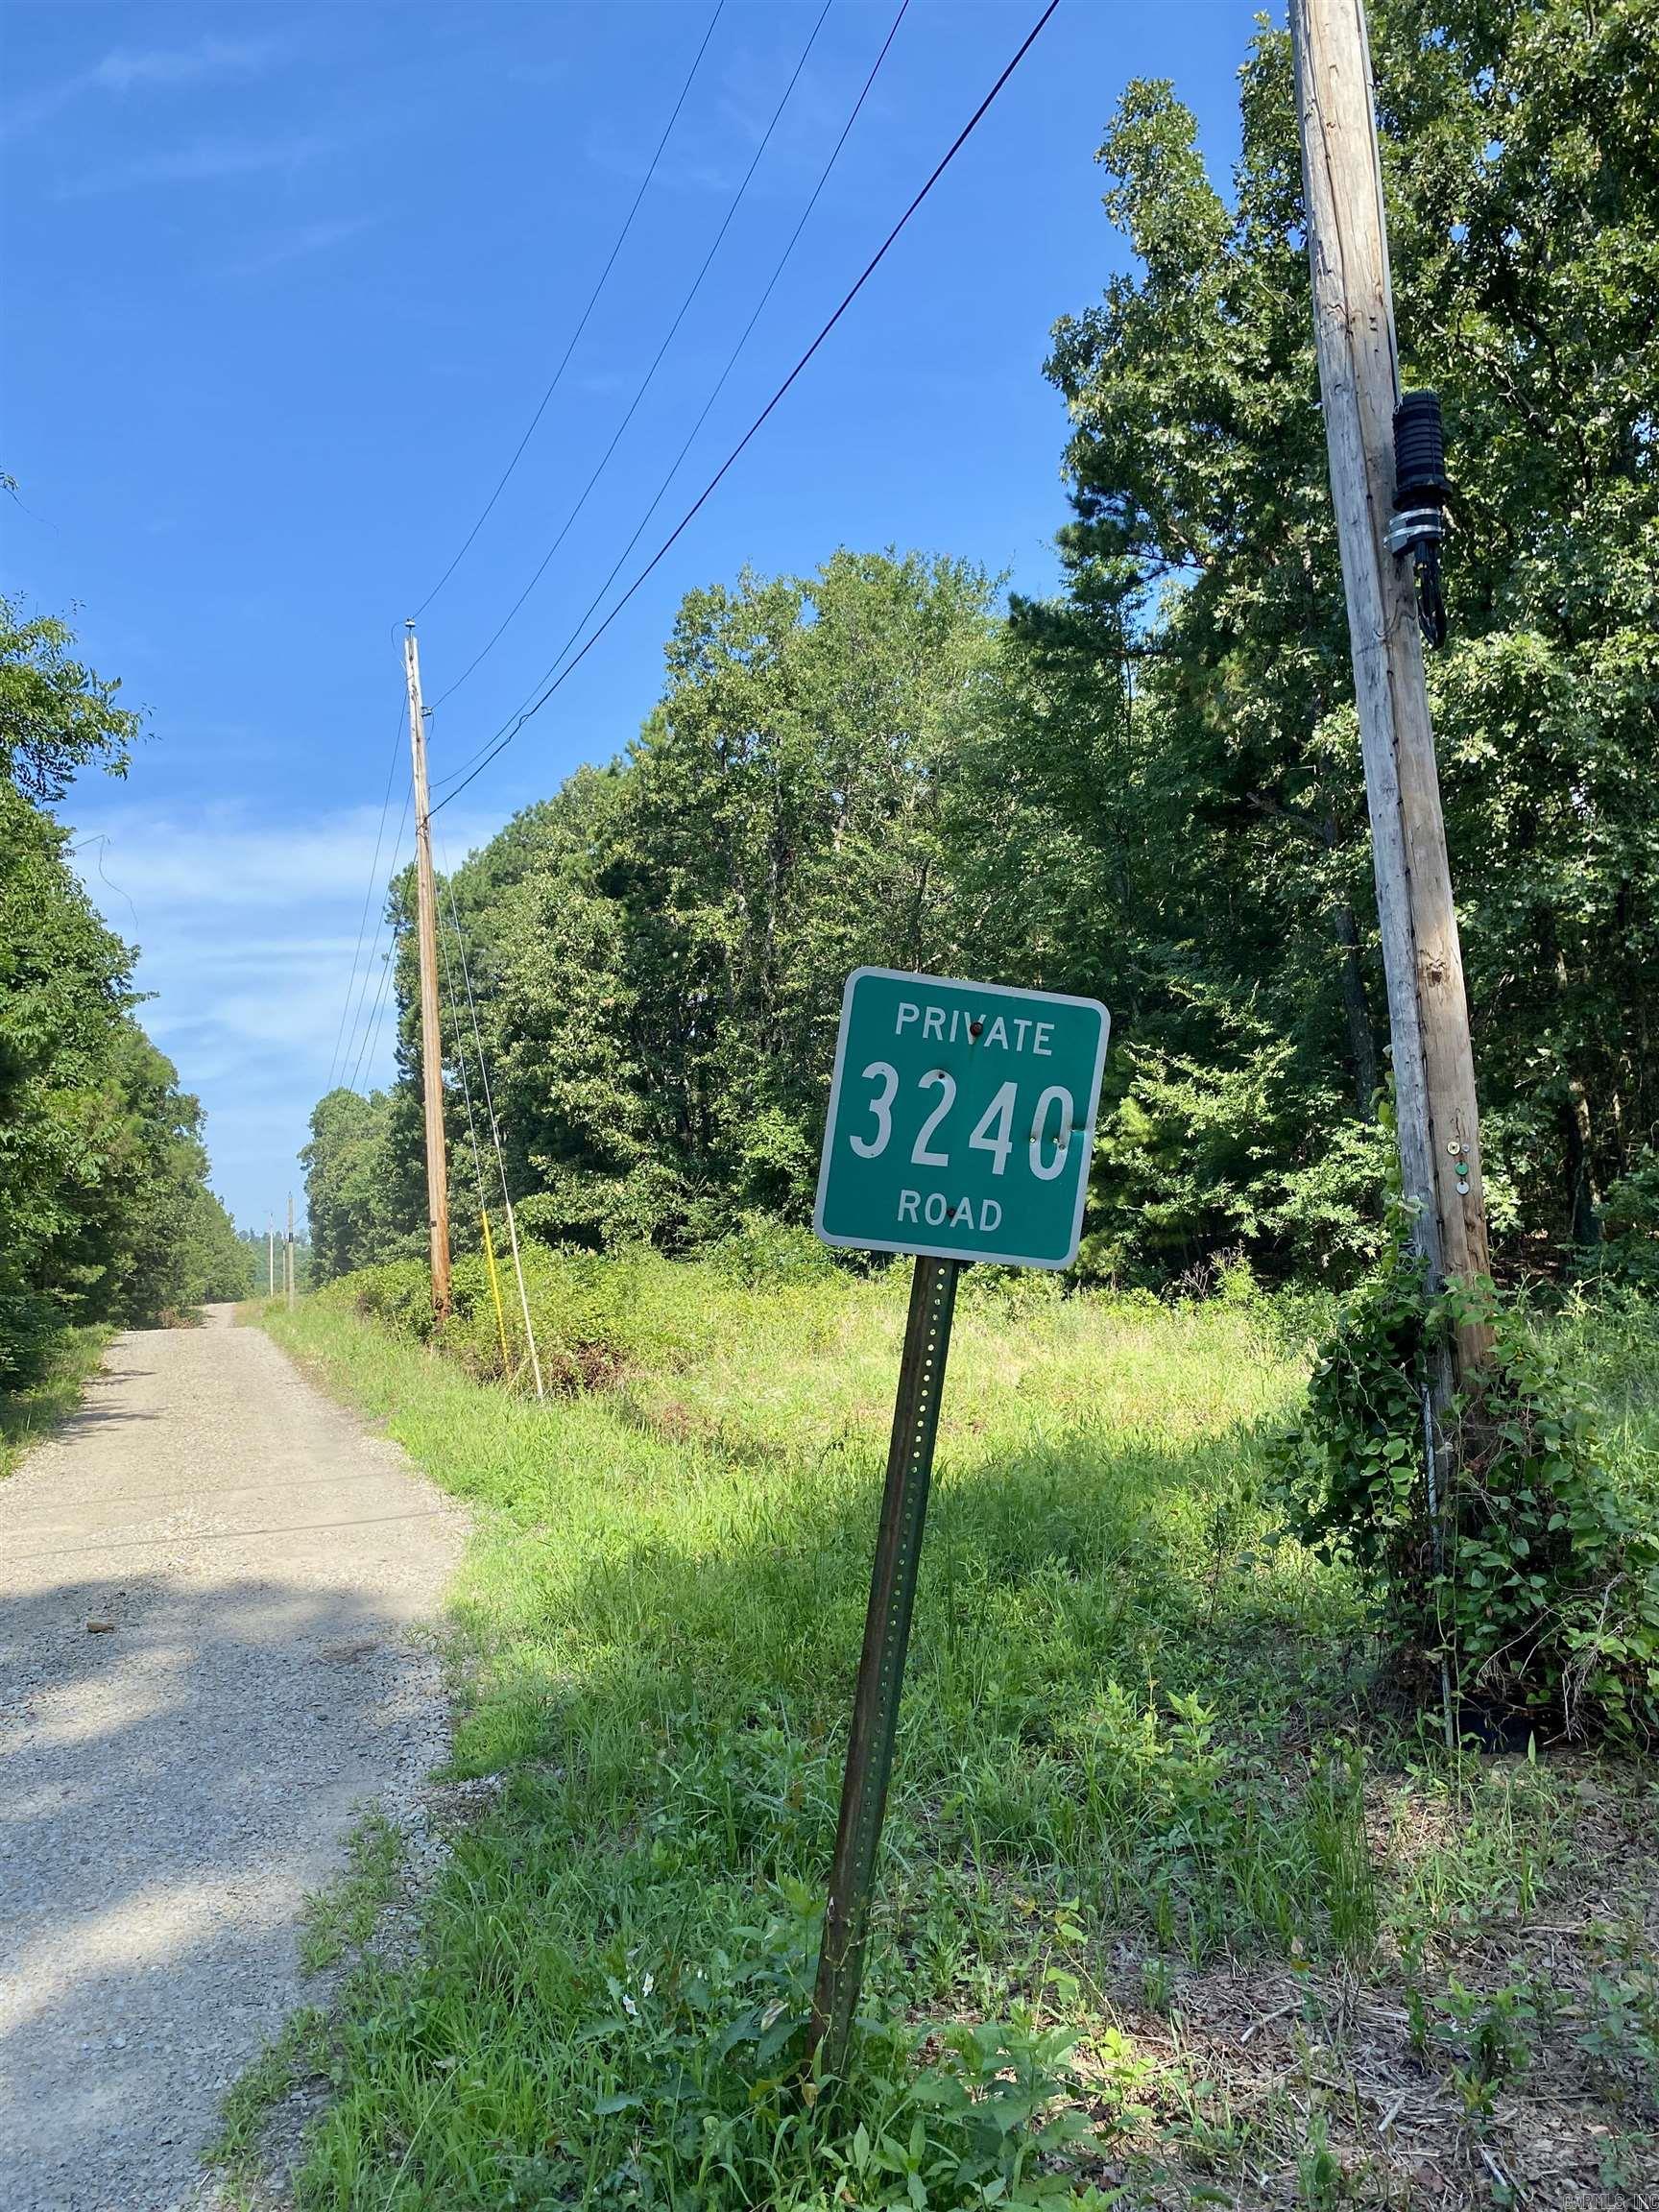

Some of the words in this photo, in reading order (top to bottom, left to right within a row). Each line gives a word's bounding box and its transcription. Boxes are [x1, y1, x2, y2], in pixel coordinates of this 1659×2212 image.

[895, 1001, 1055, 1056] PRIVATE
[849, 1061, 1074, 1181] 3240
[897, 1189, 1002, 1232] ROAD
